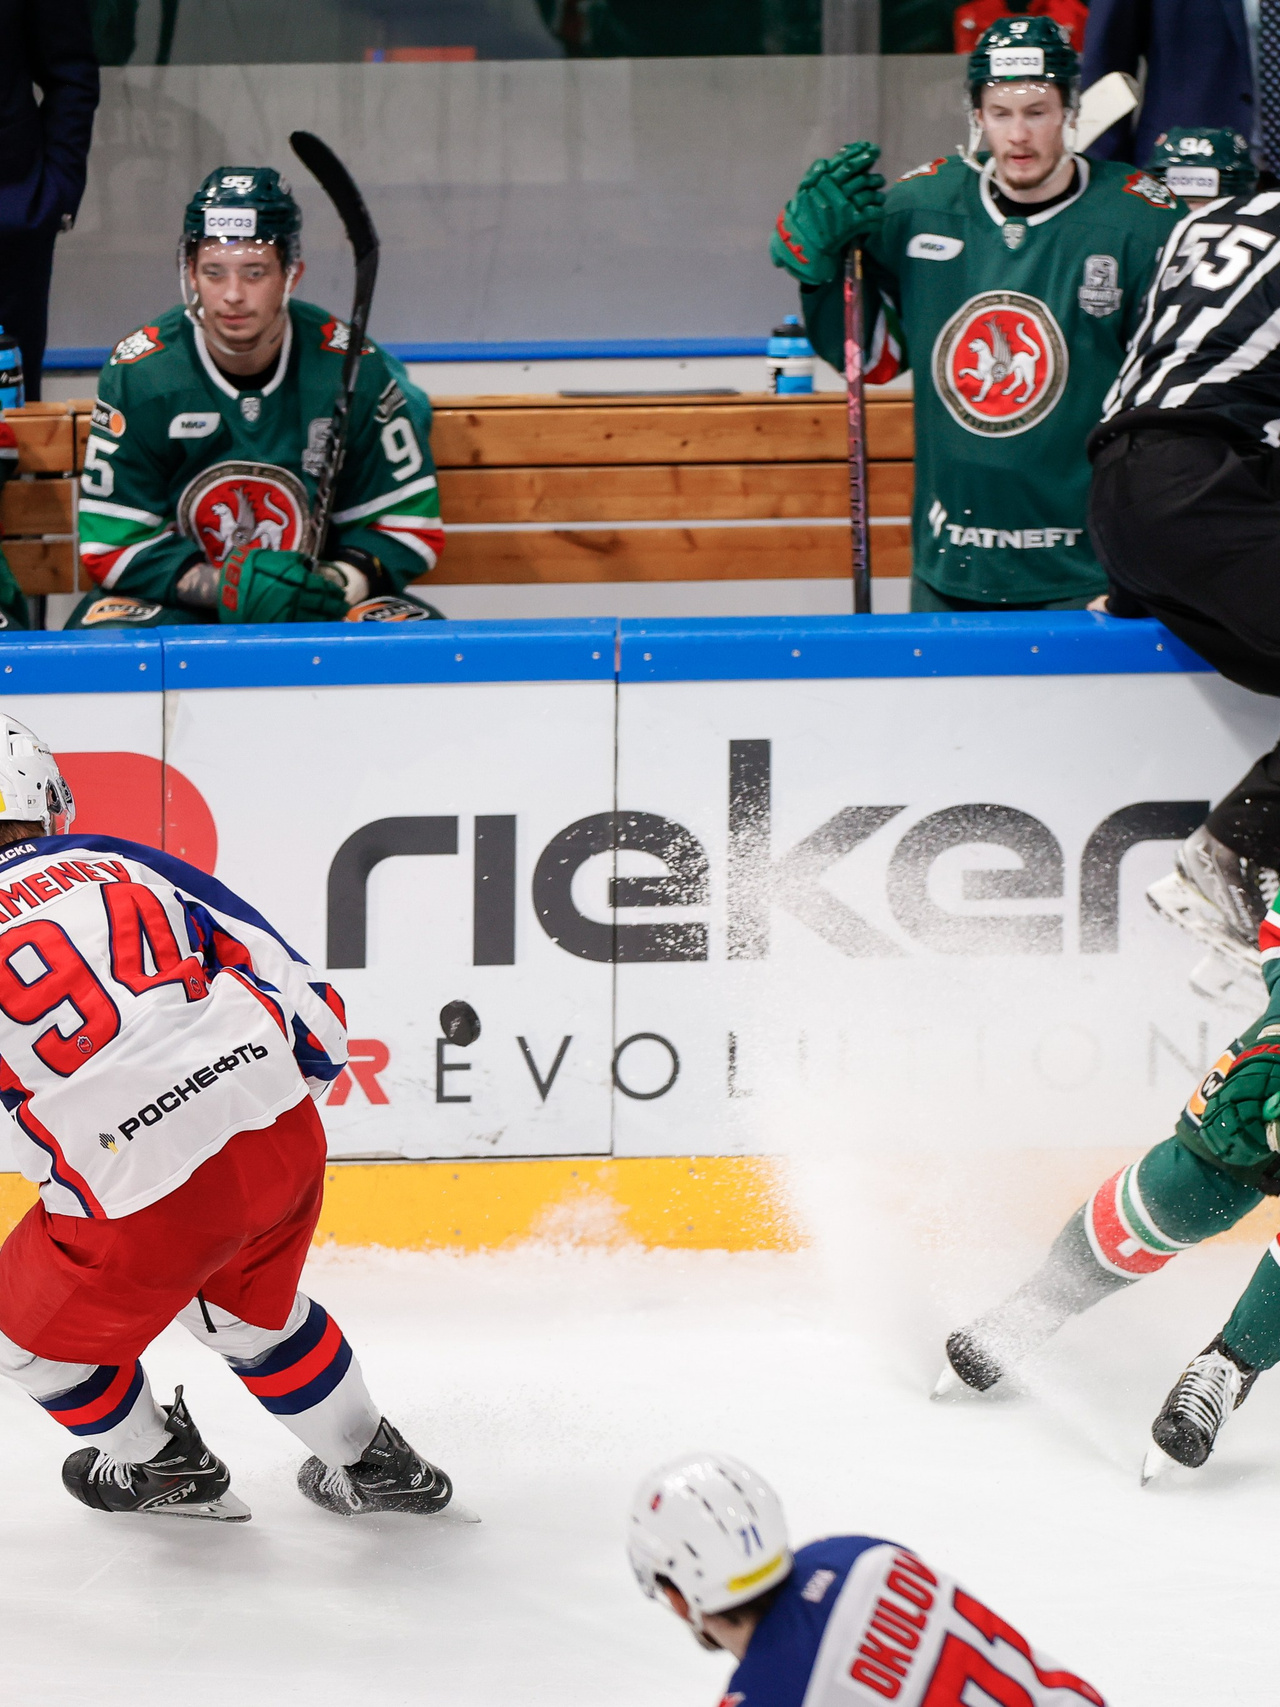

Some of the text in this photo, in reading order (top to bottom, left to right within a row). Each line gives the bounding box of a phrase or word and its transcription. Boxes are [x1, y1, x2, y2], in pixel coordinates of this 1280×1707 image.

[1009, 22, 1028, 35] 9
[221, 174, 254, 190] 95
[1160, 222, 1277, 292] 55
[81, 434, 121, 498] 5
[381, 416, 423, 482] 9
[947, 525, 1083, 550] TATNEFT
[326, 738, 1212, 970] rieker
[0, 880, 208, 1078] 94
[118, 1042, 269, 1142] РОСНЕФТЬ
[172, 1416, 188, 1428] CCM
[736, 1523, 766, 1557] 71
[850, 1550, 940, 1701] OKULOV
